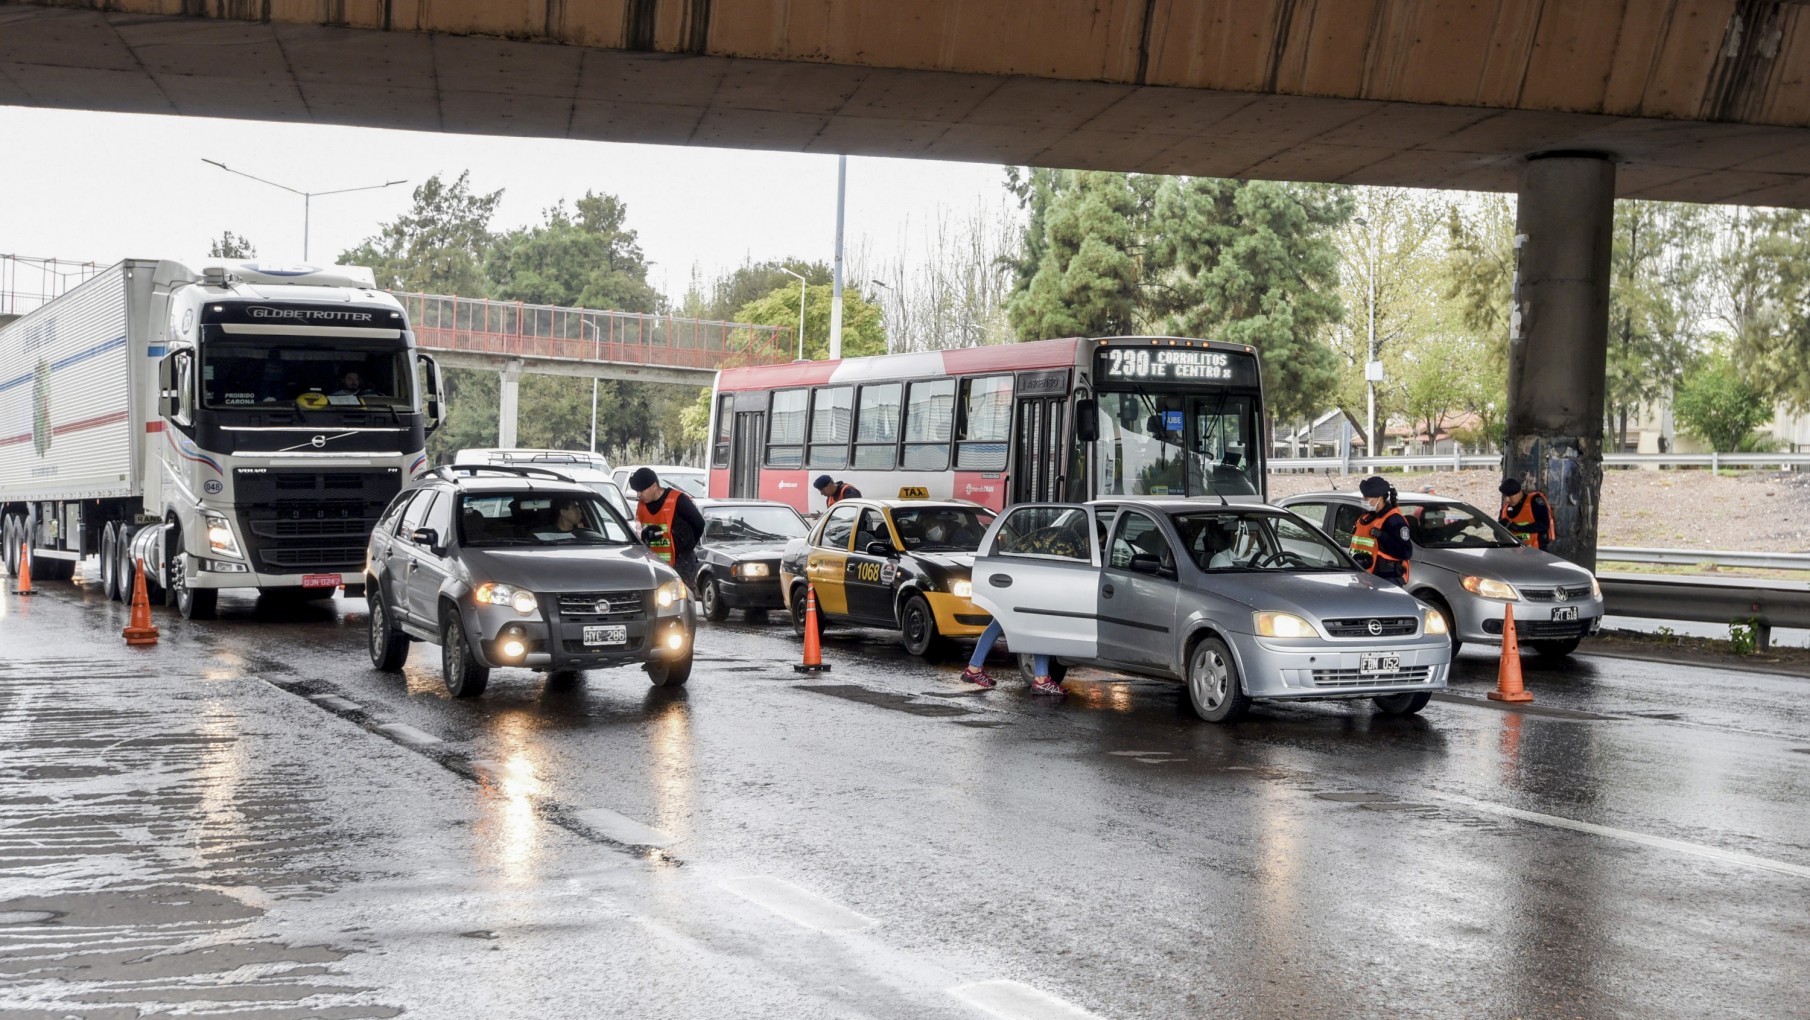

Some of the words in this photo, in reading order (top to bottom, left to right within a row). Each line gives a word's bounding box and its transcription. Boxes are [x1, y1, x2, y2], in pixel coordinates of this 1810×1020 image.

[253, 309, 372, 322] GLOBETROTTER
[1109, 349, 1149, 376] 230
[1158, 352, 1227, 366] CORRALITOS
[1151, 363, 1166, 376] TE
[1175, 364, 1221, 377] CENTRO
[857, 562, 880, 581] 1068
[585, 631, 603, 642] HYC
[607, 630, 625, 641] 286
[1382, 657, 1399, 669] 052
